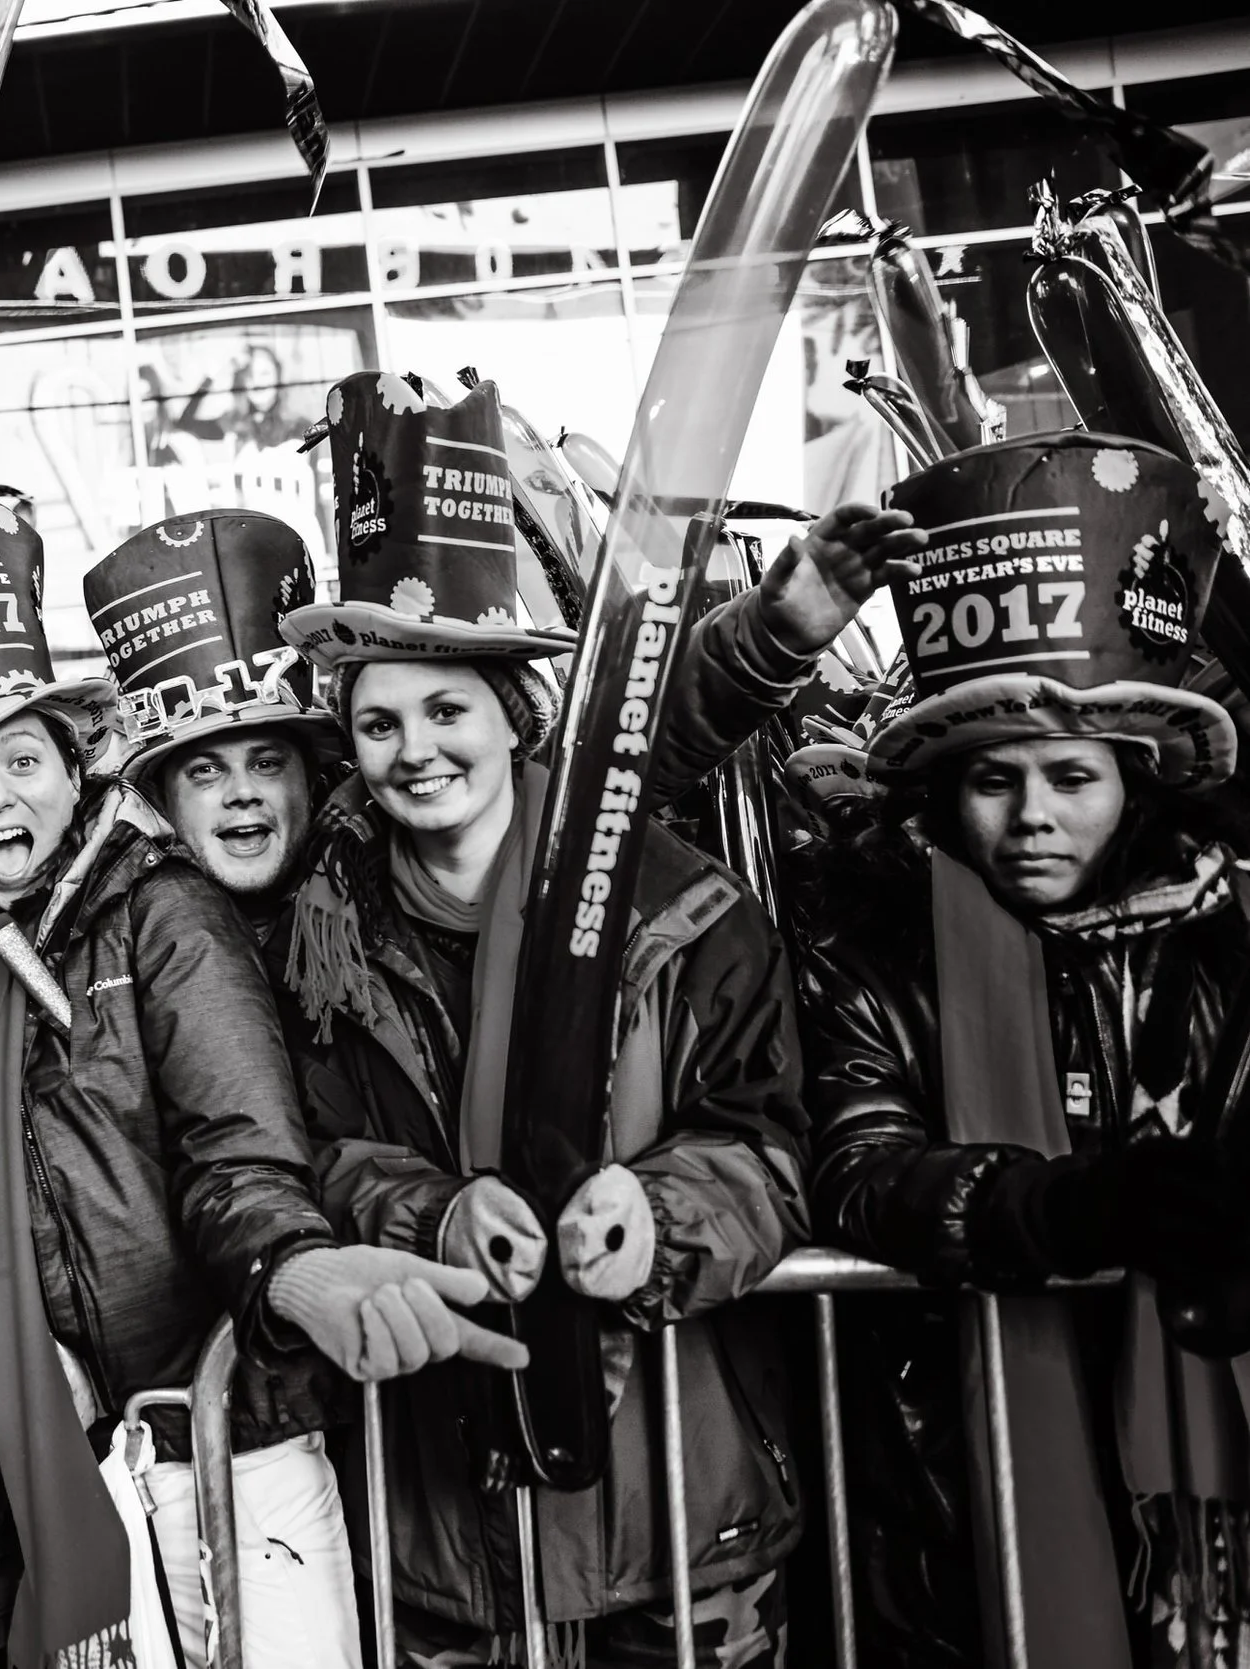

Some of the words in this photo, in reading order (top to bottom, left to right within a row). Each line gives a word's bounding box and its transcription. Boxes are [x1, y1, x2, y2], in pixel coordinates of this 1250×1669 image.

[976, 528, 1081, 556] SQUARE
[908, 573, 951, 595] NEW
[952, 558, 1034, 585] YEAR'S
[1035, 554, 1084, 573] EVE
[100, 589, 212, 649] RIUMPH
[912, 580, 1086, 658] 2017
[1122, 588, 1183, 621] planet
[109, 608, 218, 669] OGETHER
[1131, 610, 1189, 644] fitness
[612, 562, 683, 757] planet
[809, 764, 839, 780] 2017
[568, 765, 643, 959] fitness
[93, 973, 134, 991] Columbi
